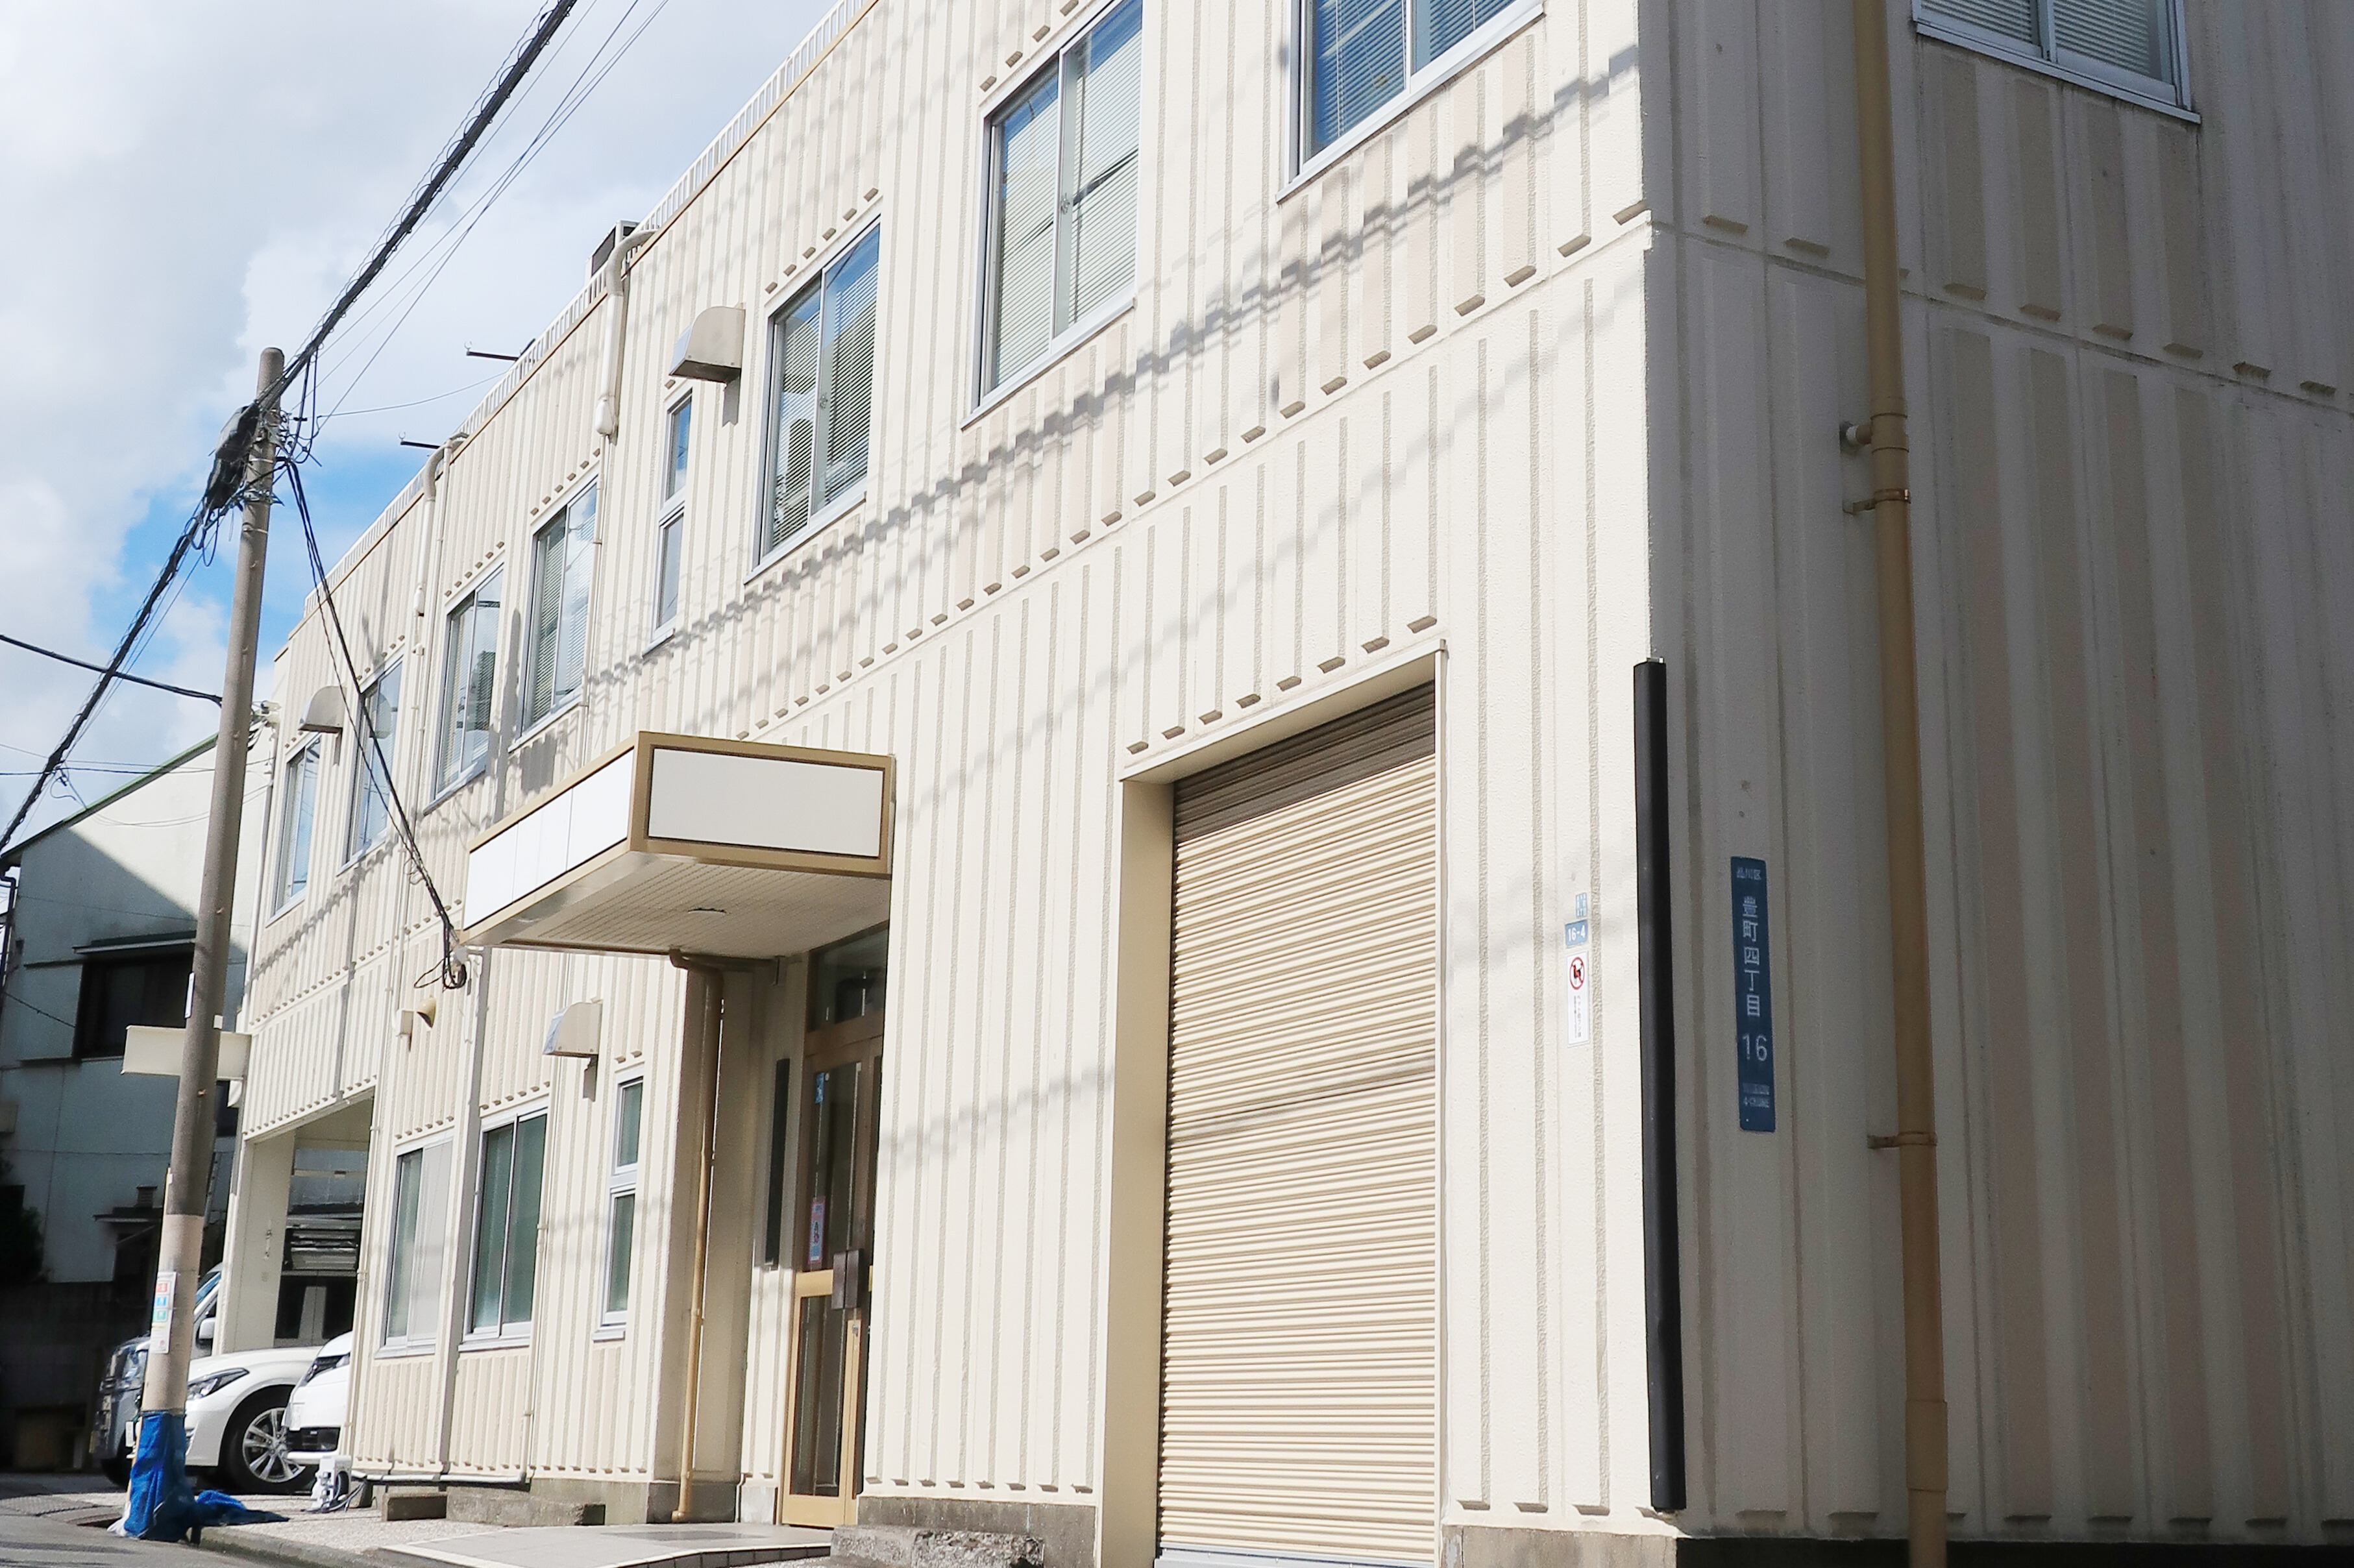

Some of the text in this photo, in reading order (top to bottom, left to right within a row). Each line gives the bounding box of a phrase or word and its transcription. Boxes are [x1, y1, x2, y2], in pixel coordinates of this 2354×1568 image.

[1568, 925, 1586, 942] 16-4
[1743, 896, 1760, 1017] 豊町四丁目
[1743, 1035, 1767, 1061] 16
